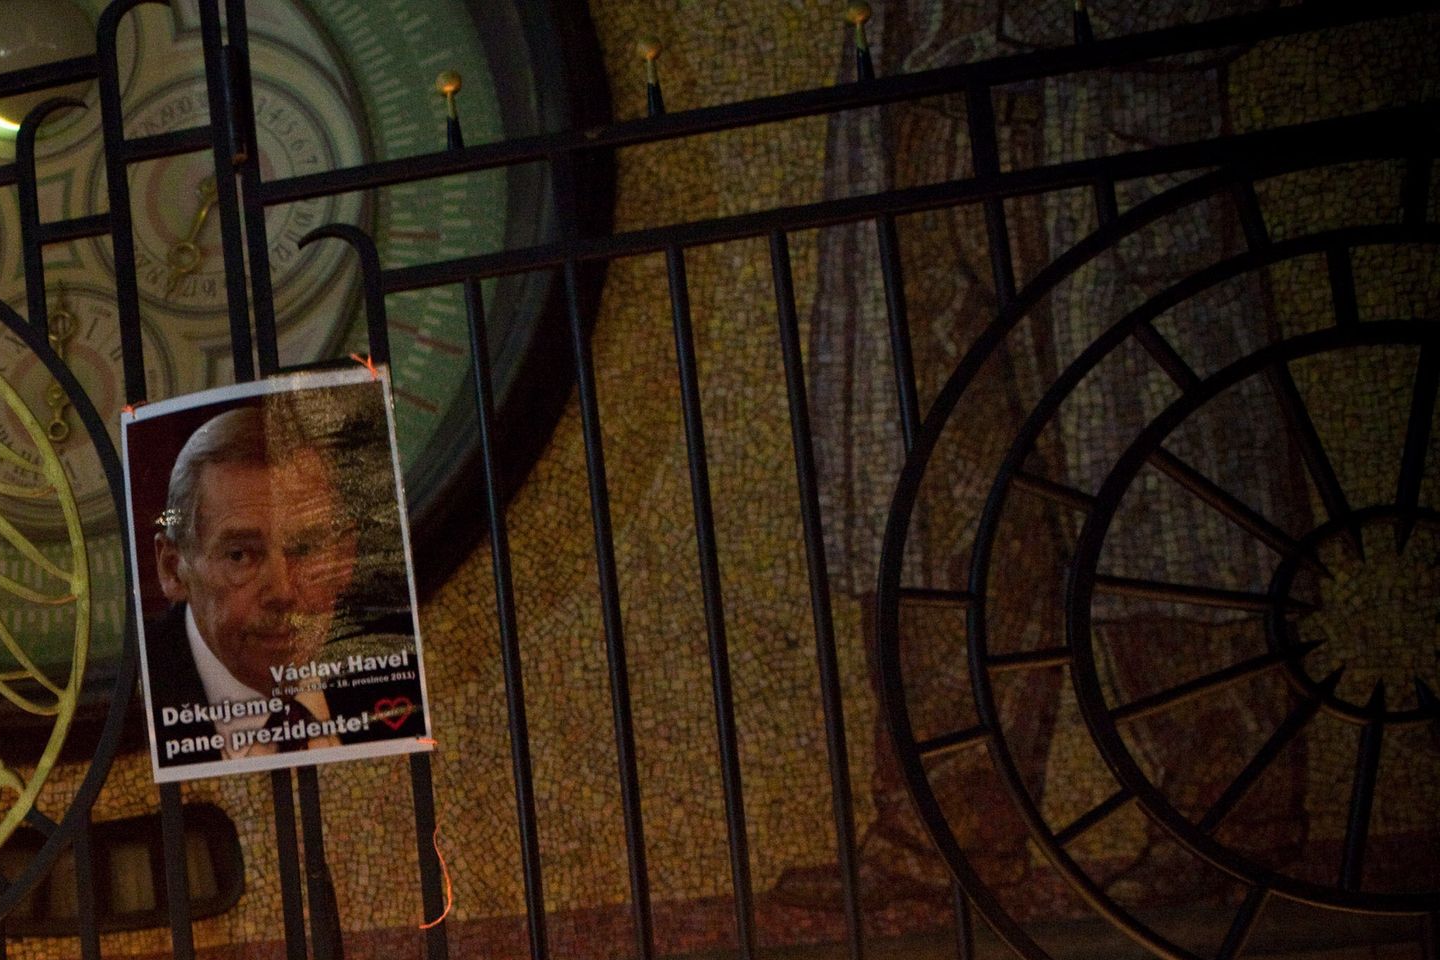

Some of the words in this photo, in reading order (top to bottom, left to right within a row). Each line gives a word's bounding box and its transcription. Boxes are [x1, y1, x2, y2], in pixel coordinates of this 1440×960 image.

[270, 660, 342, 683] Václav
[347, 650, 409, 674] Havel
[352, 674, 390, 688] prosince
[391, 671, 416, 681] 2011)
[162, 697, 291, 727] Děkujeme,
[165, 734, 225, 759] pane
[231, 712, 370, 751] prezidente!
